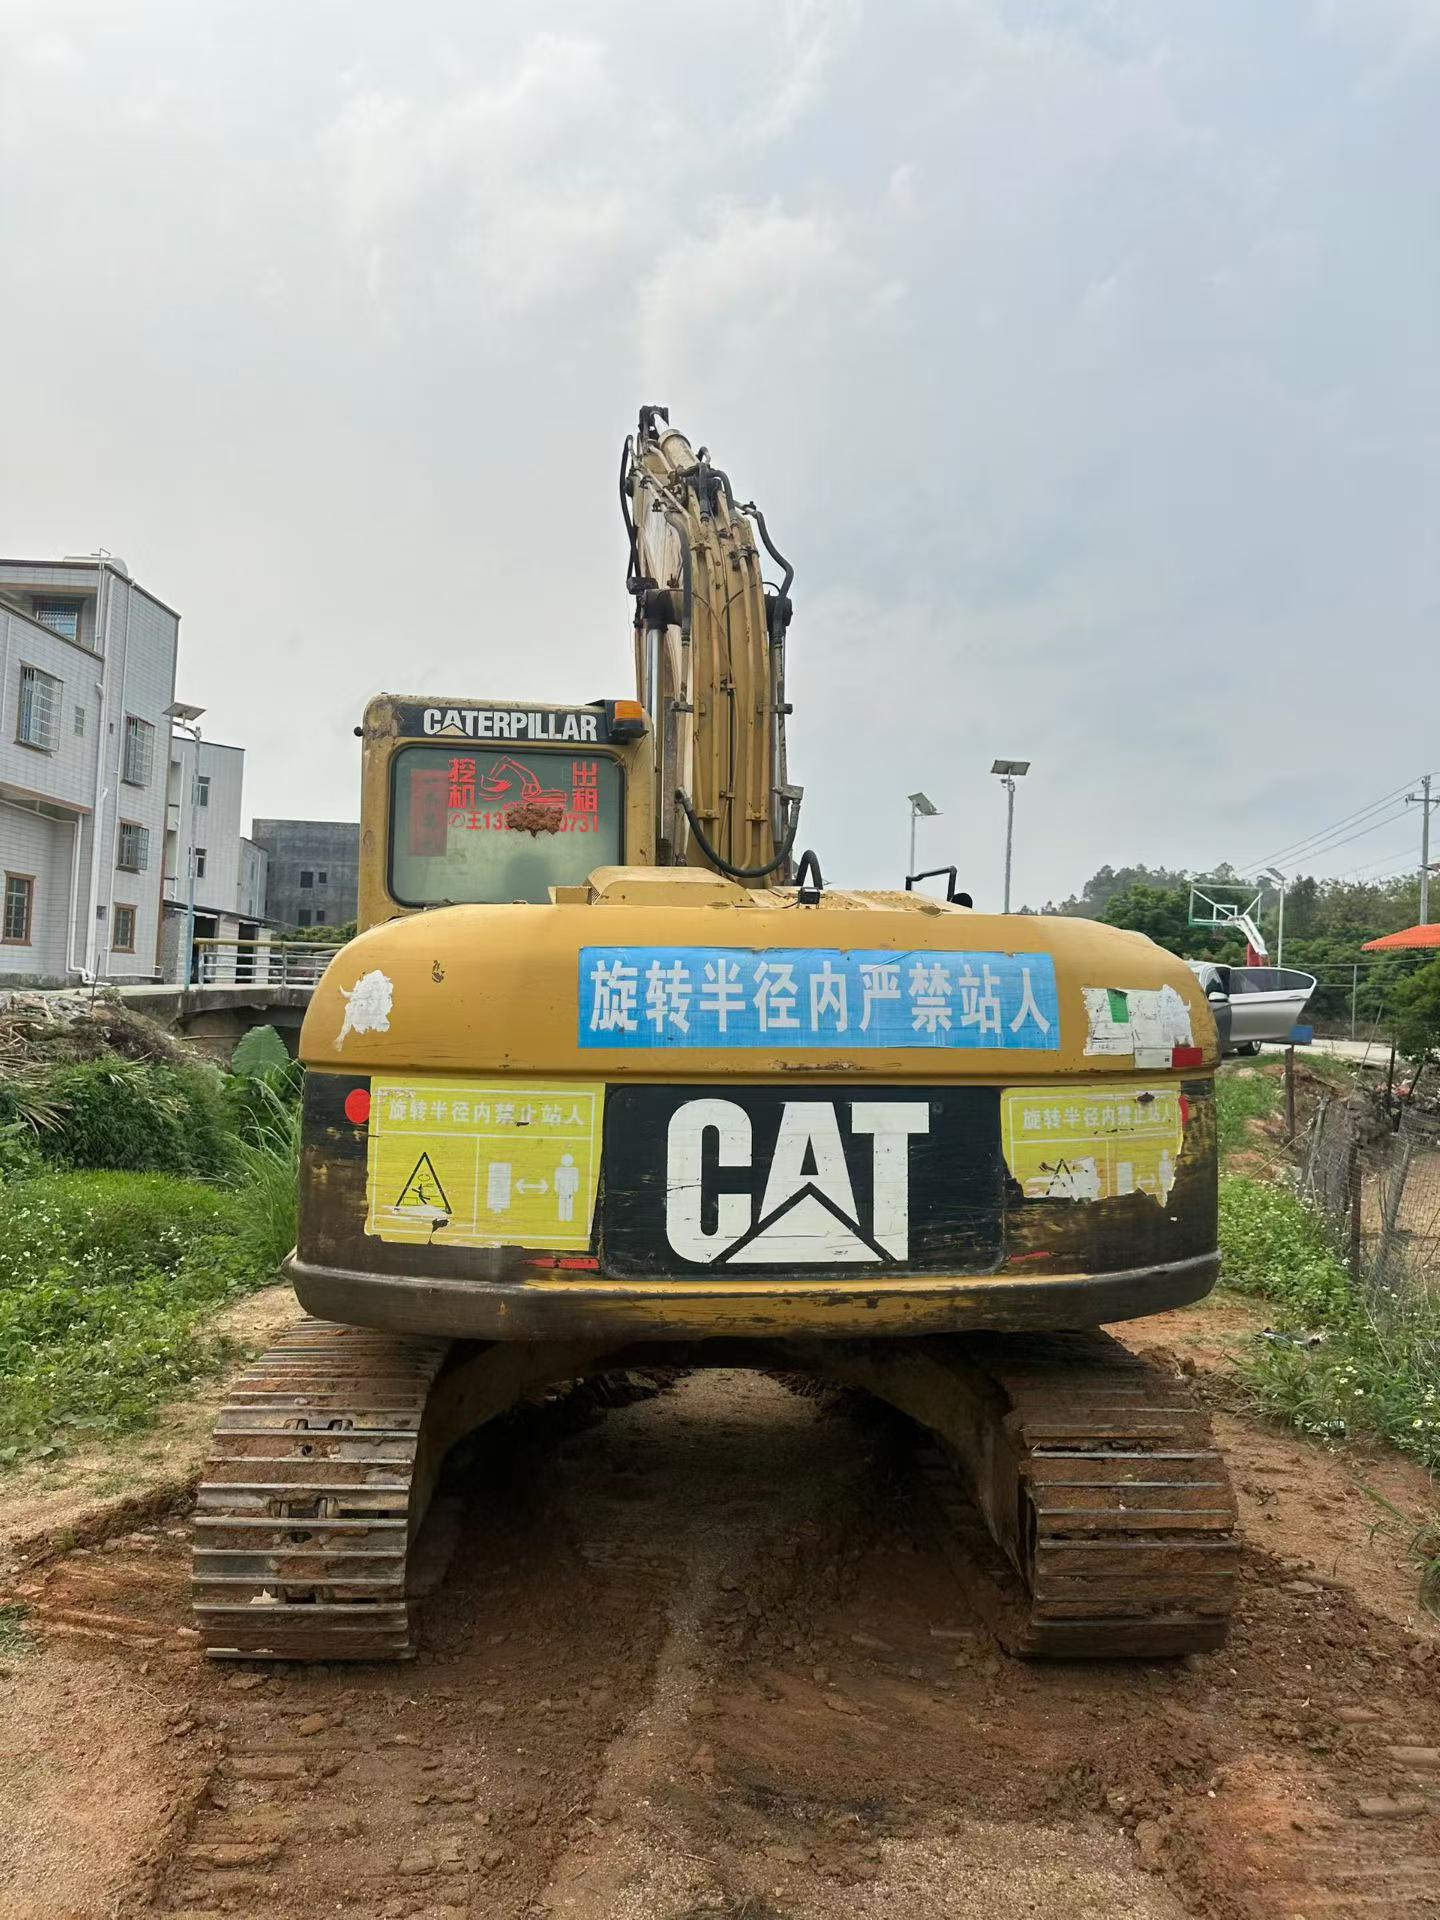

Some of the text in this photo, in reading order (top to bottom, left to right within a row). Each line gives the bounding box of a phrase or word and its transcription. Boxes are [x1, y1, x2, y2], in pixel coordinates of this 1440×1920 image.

[423, 708, 598, 742] CATERPILLAR
[447, 758, 476, 809] 挖机
[571, 760, 599, 813] 出租
[589, 958, 1051, 1035] 旋转半径内严禁站人
[388, 1099, 584, 1126] 旋转半径内禁止站人
[666, 1098, 930, 1264] CAT
